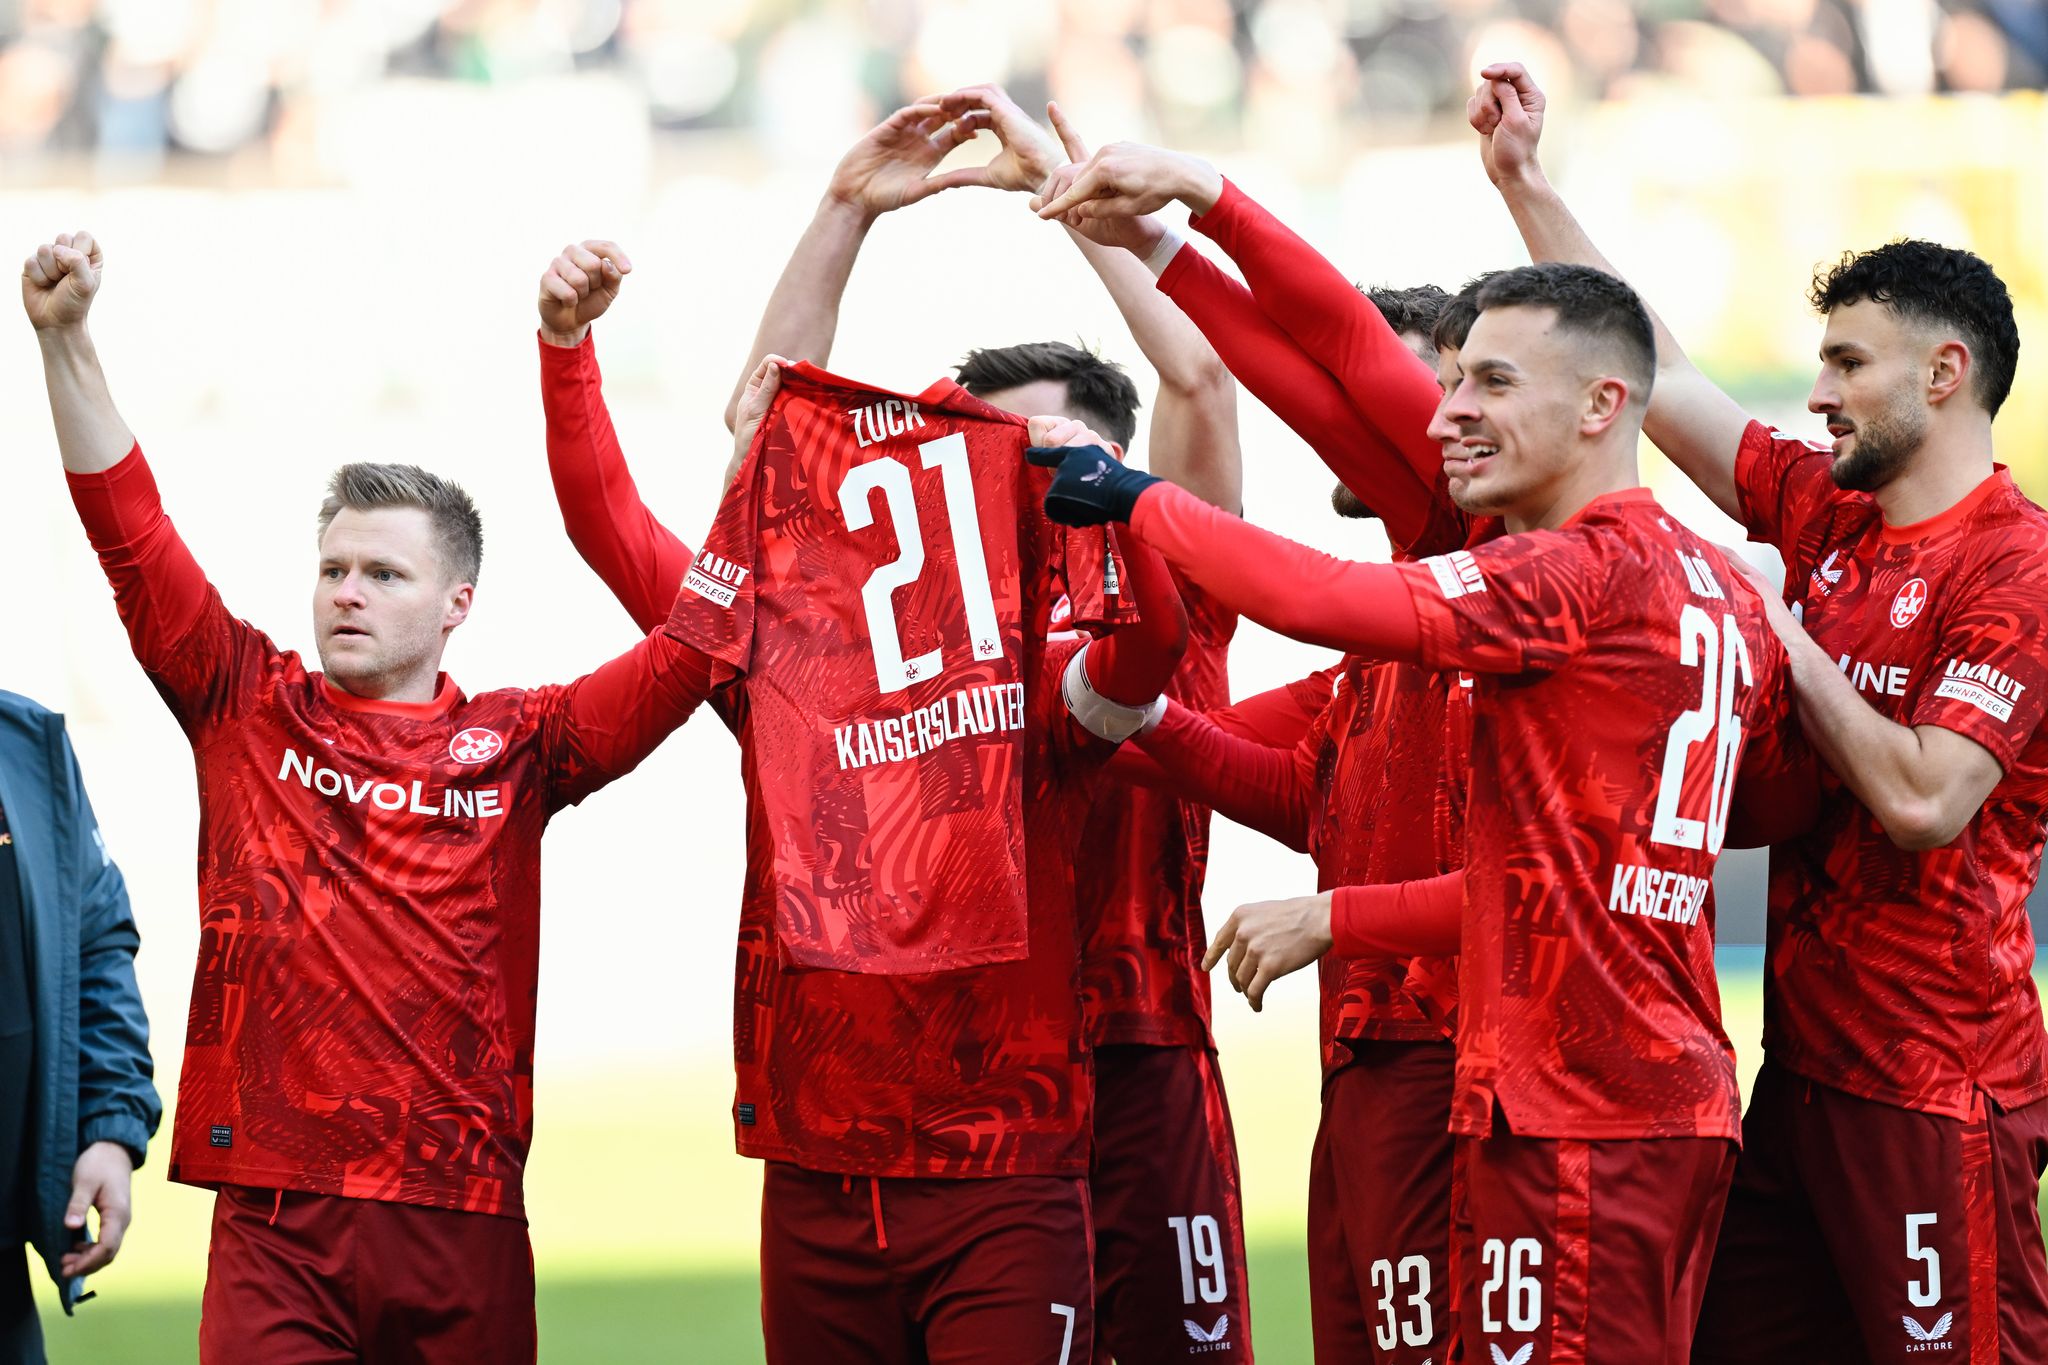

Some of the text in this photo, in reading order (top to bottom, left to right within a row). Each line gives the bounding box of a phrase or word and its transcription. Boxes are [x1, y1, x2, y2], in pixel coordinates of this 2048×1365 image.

[848, 399, 926, 448] ZUCK
[837, 432, 1003, 694] 21
[1651, 604, 1753, 856] 26
[1941, 684, 2007, 716] ZAHNPFLEGE
[1168, 1214, 1228, 1304] 19
[1370, 1255, 1431, 1350] 33
[1482, 1238, 1542, 1333] 26
[1906, 1212, 1941, 1307] 5
[1050, 1303, 1075, 1365] 7
[1189, 1341, 1231, 1354] CASTORE
[1906, 1341, 1953, 1352] CASTORE
